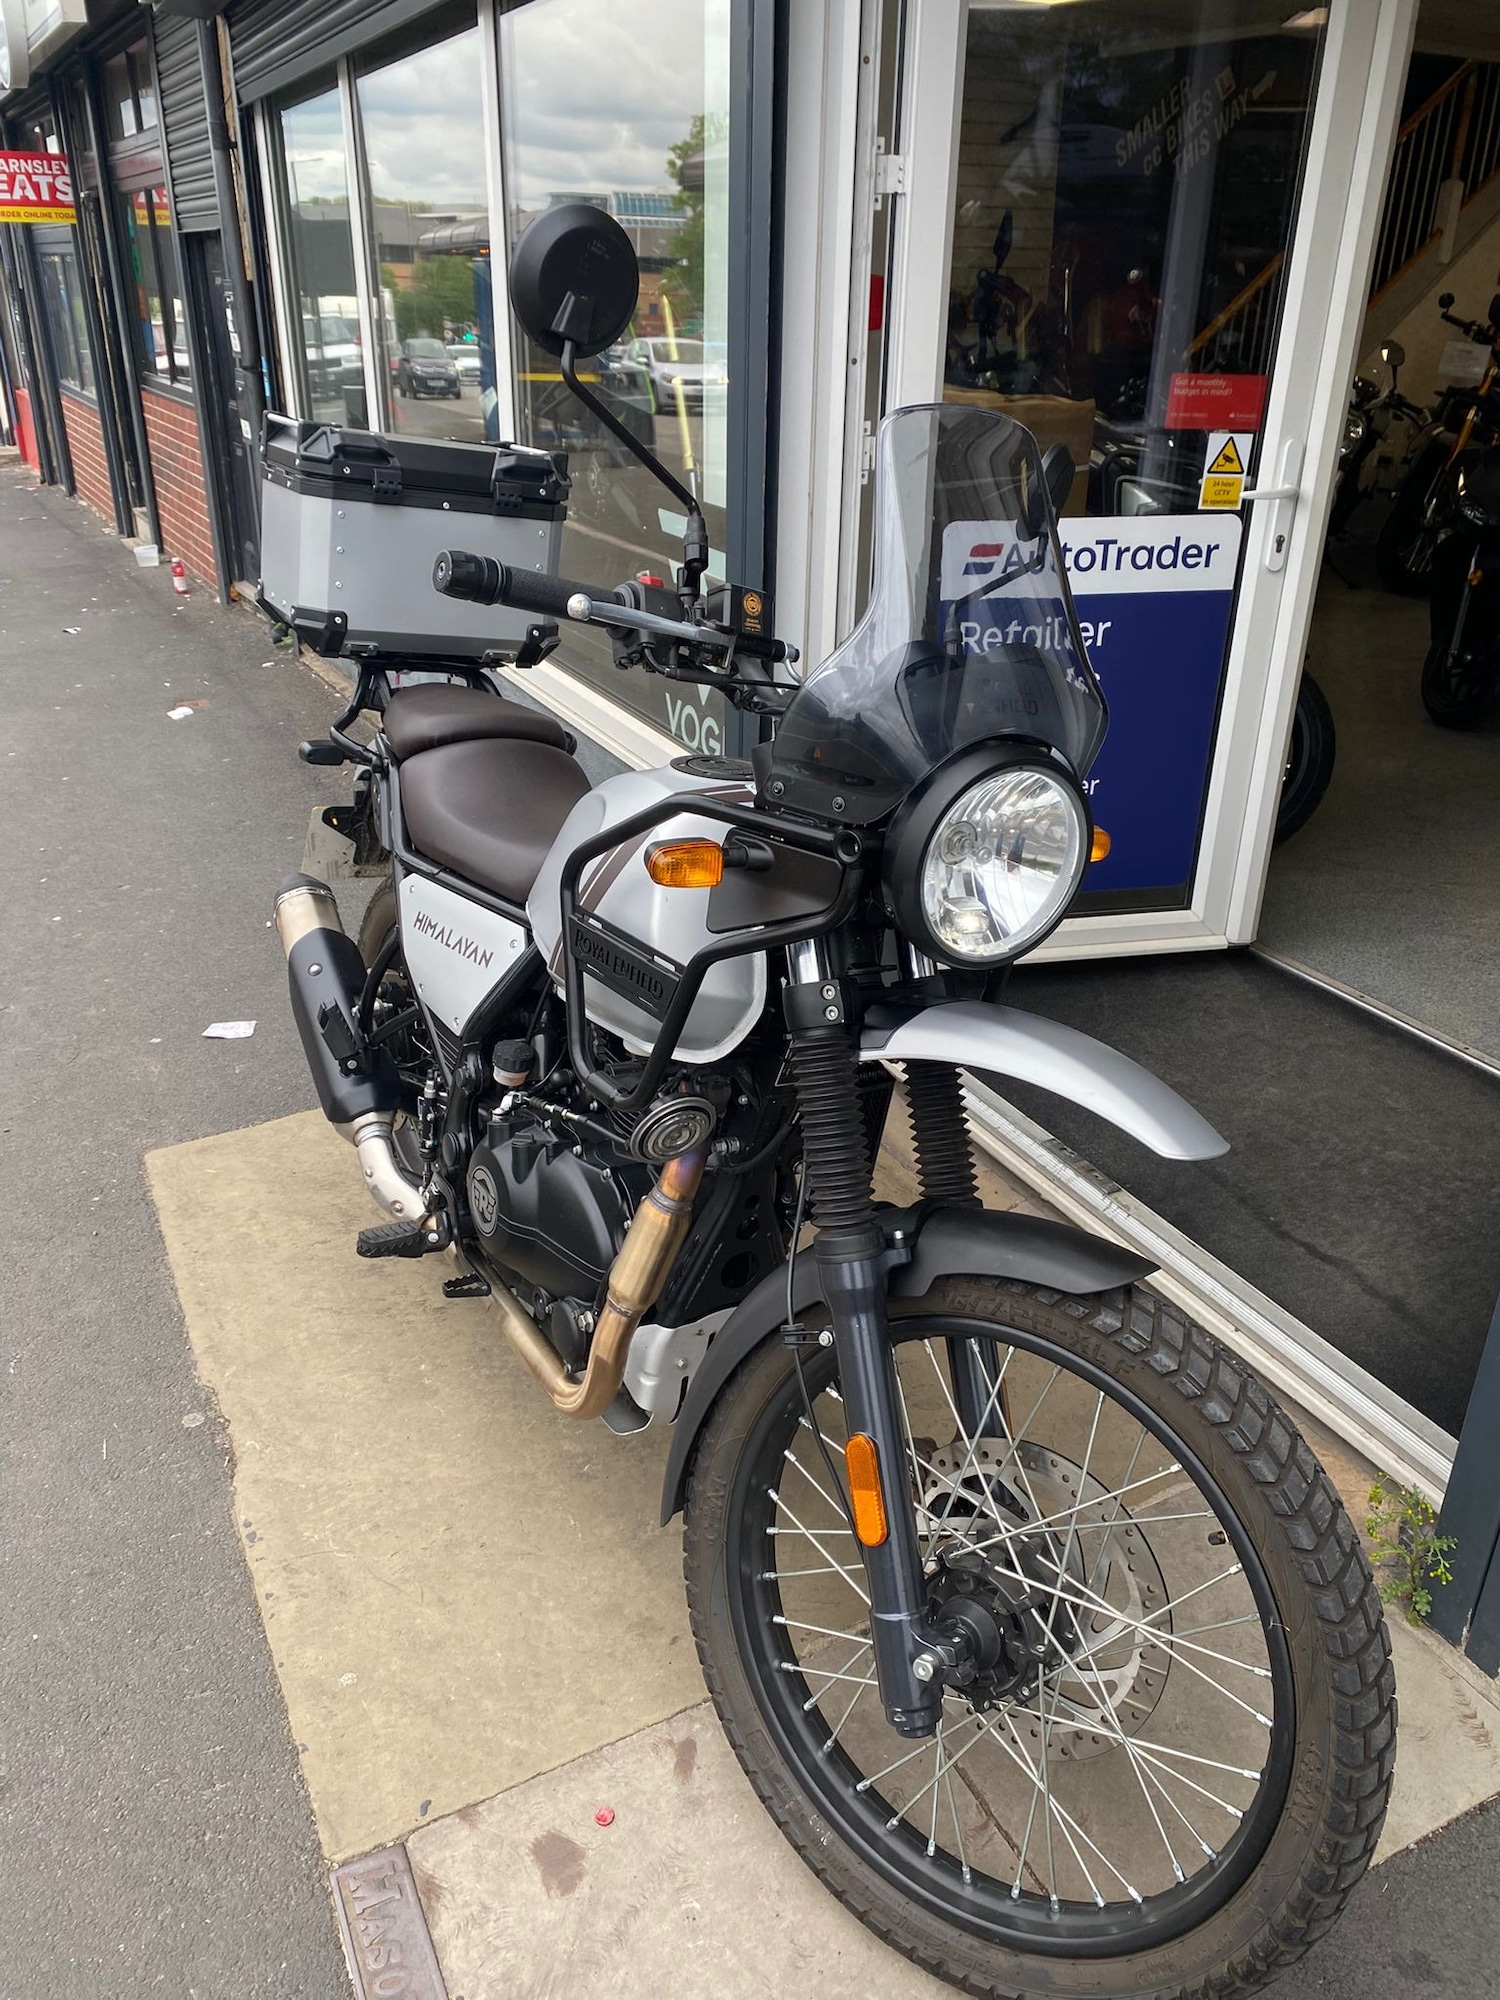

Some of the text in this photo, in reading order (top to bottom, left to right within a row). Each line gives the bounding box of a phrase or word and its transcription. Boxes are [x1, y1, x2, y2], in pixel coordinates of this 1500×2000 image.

[1116, 76, 1191, 167] SMALLER
[1143, 146, 1162, 176] CC
[1166, 89, 1213, 154] BIKES
[1173, 88, 1249, 180] THIS WAY
[0, 174, 74, 202] EATS
[24, 211, 53, 219] ONLINE
[1173, 387, 1200, 397] budget
[1202, 387, 1209, 395] in
[1175, 377, 1189, 386] Got
[1196, 378, 1227, 388] monthly
[413, 910, 494, 969] HIMALAYAN
[575, 928, 664, 1000] ROYAL ENFIELD
